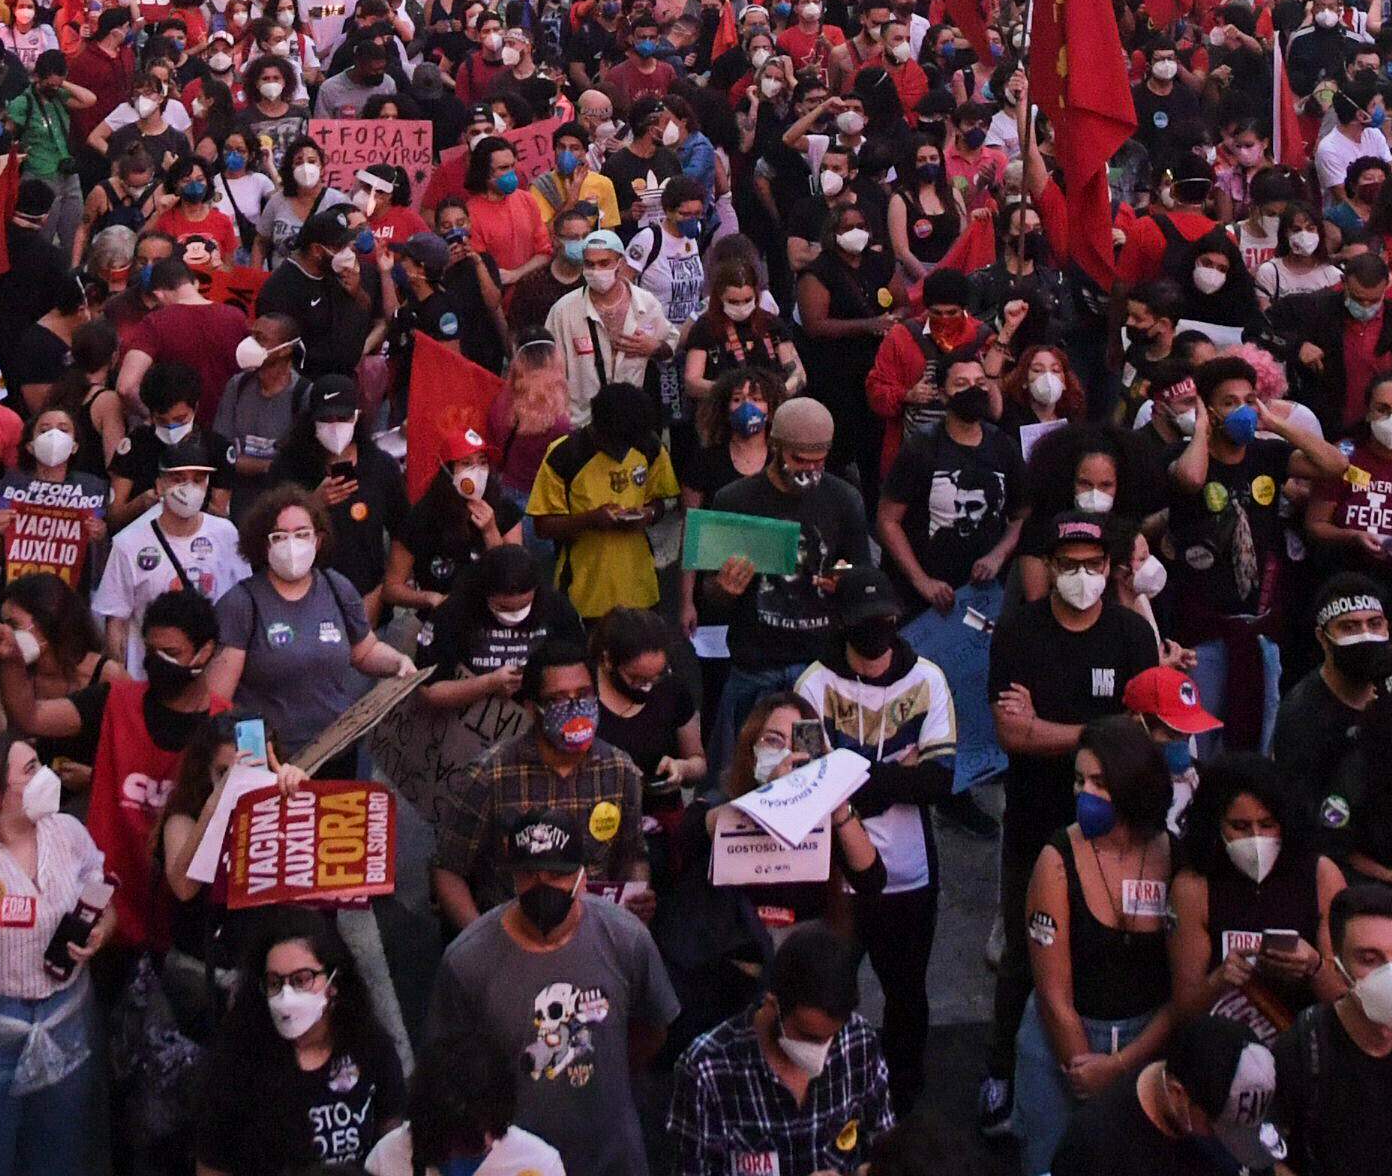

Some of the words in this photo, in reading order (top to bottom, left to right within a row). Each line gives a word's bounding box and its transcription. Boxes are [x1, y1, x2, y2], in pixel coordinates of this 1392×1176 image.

[340, 126, 403, 147] FORA
[2, 487, 103, 508] BOLSONARO!
[28, 481, 83, 496] #FORA
[13, 514, 82, 540] VACINA
[8, 538, 78, 565] AUXÍLIO
[472, 656, 501, 666] mata
[248, 794, 282, 896] VACINA
[279, 790, 317, 888] AUXÍLIO
[317, 789, 368, 887] FORA
[366, 791, 390, 885] BOLSONARO
[726, 843, 776, 854] GOSTOSO
